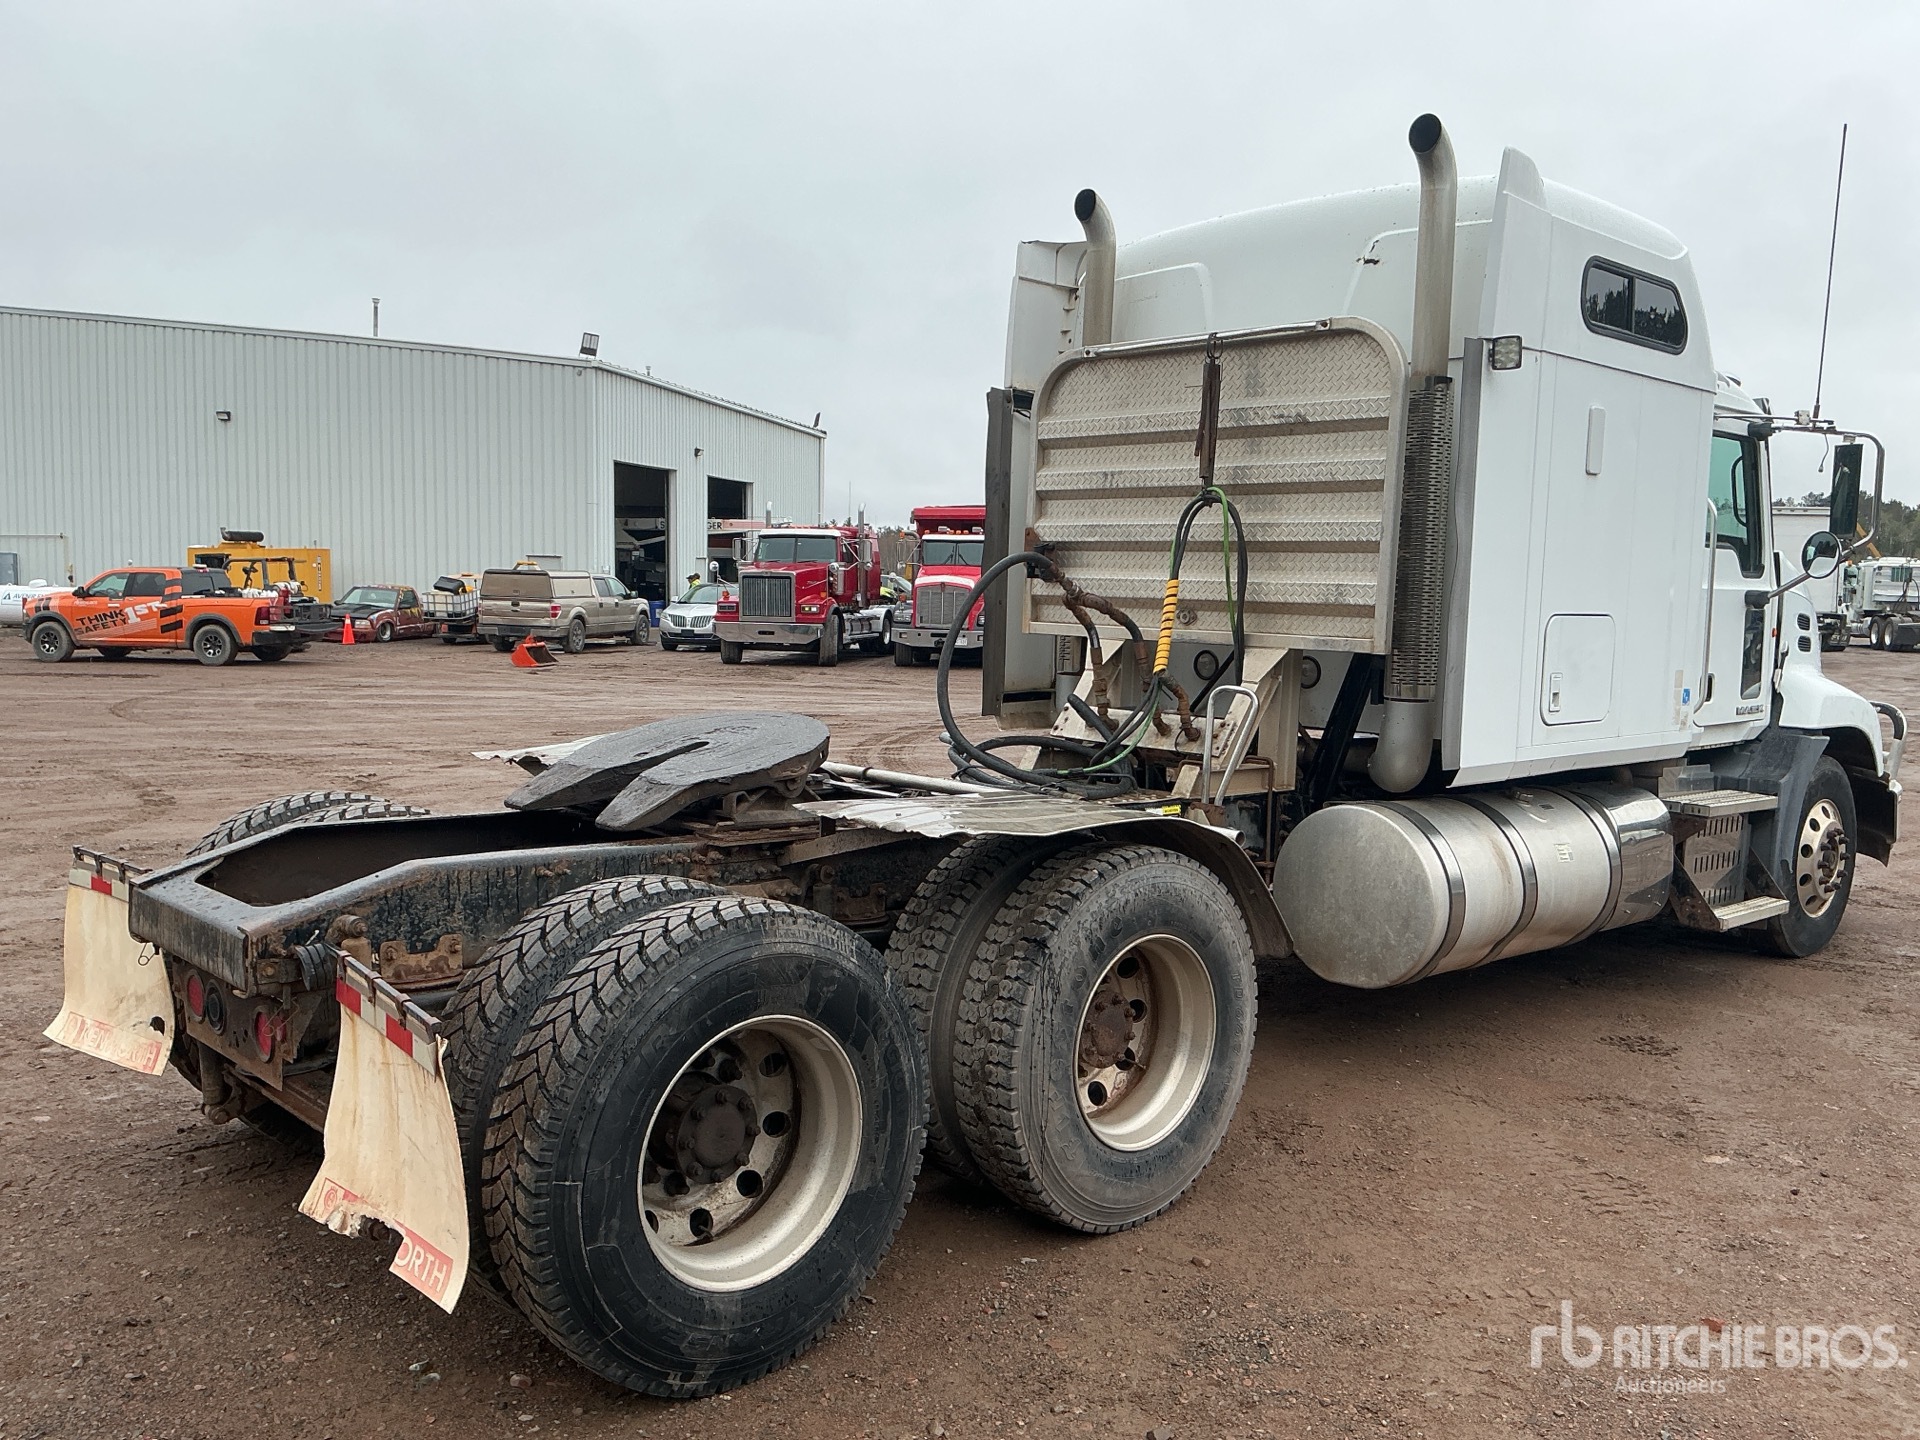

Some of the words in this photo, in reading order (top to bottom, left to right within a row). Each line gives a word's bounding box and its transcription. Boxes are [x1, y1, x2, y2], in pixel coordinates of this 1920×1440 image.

[76, 609, 125, 626] THINK
[124, 601, 161, 624] 1ST
[74, 618, 127, 635] SAFETY
